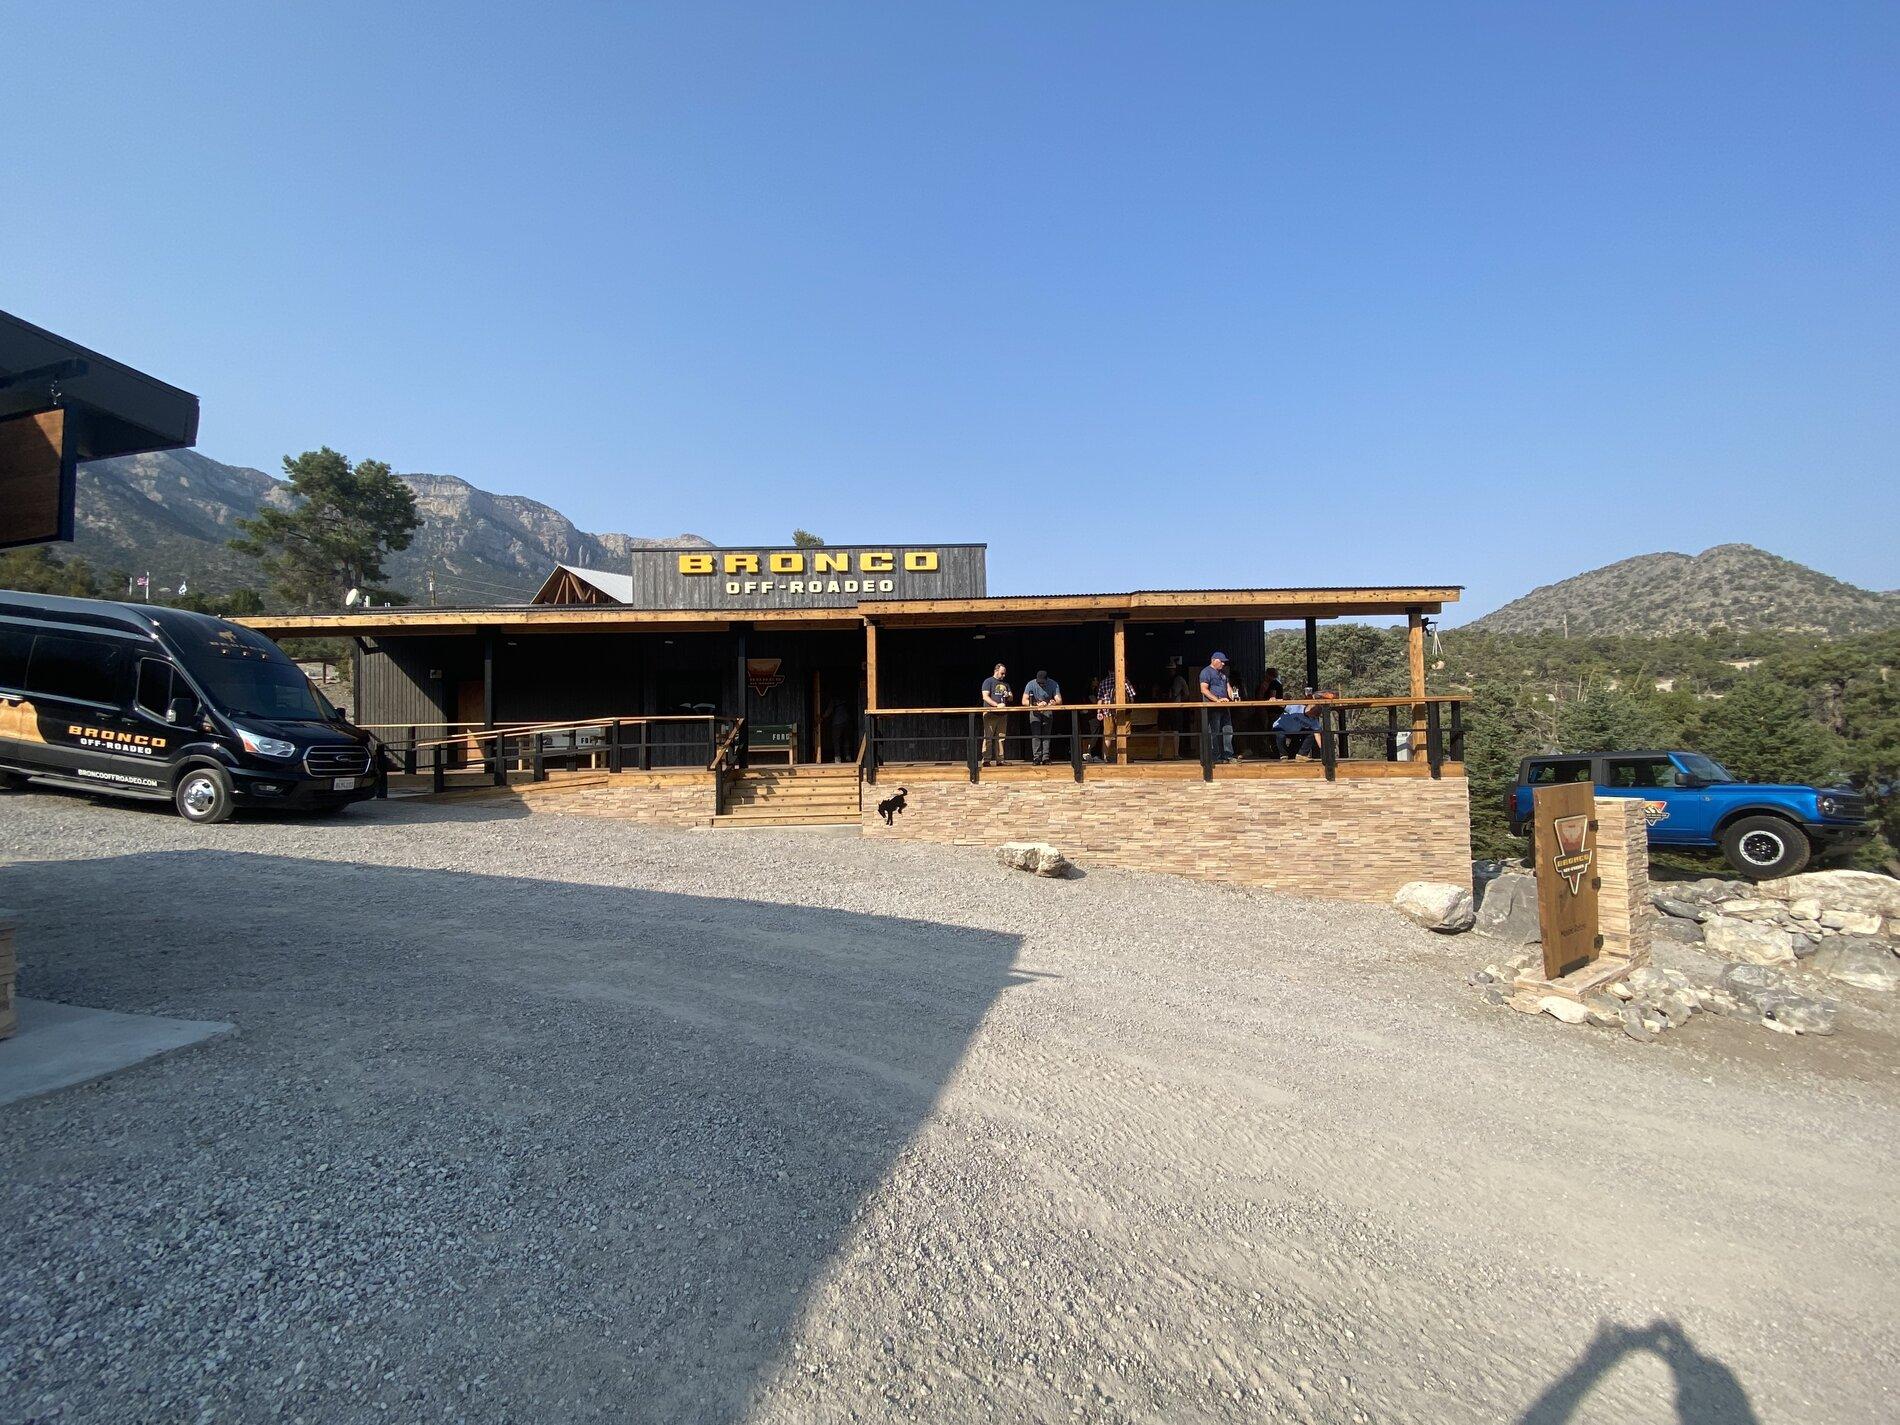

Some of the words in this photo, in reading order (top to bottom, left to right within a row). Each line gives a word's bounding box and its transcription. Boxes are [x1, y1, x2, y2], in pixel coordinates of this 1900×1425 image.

[679, 552, 939, 574] BRONCO
[726, 579, 894, 595] OFF-ROADEO
[68, 725, 167, 748] BRONCO
[80, 738, 152, 755] OFF-ROADEO
[77, 768, 158, 787] BRONCOOFFROADEO.COM
